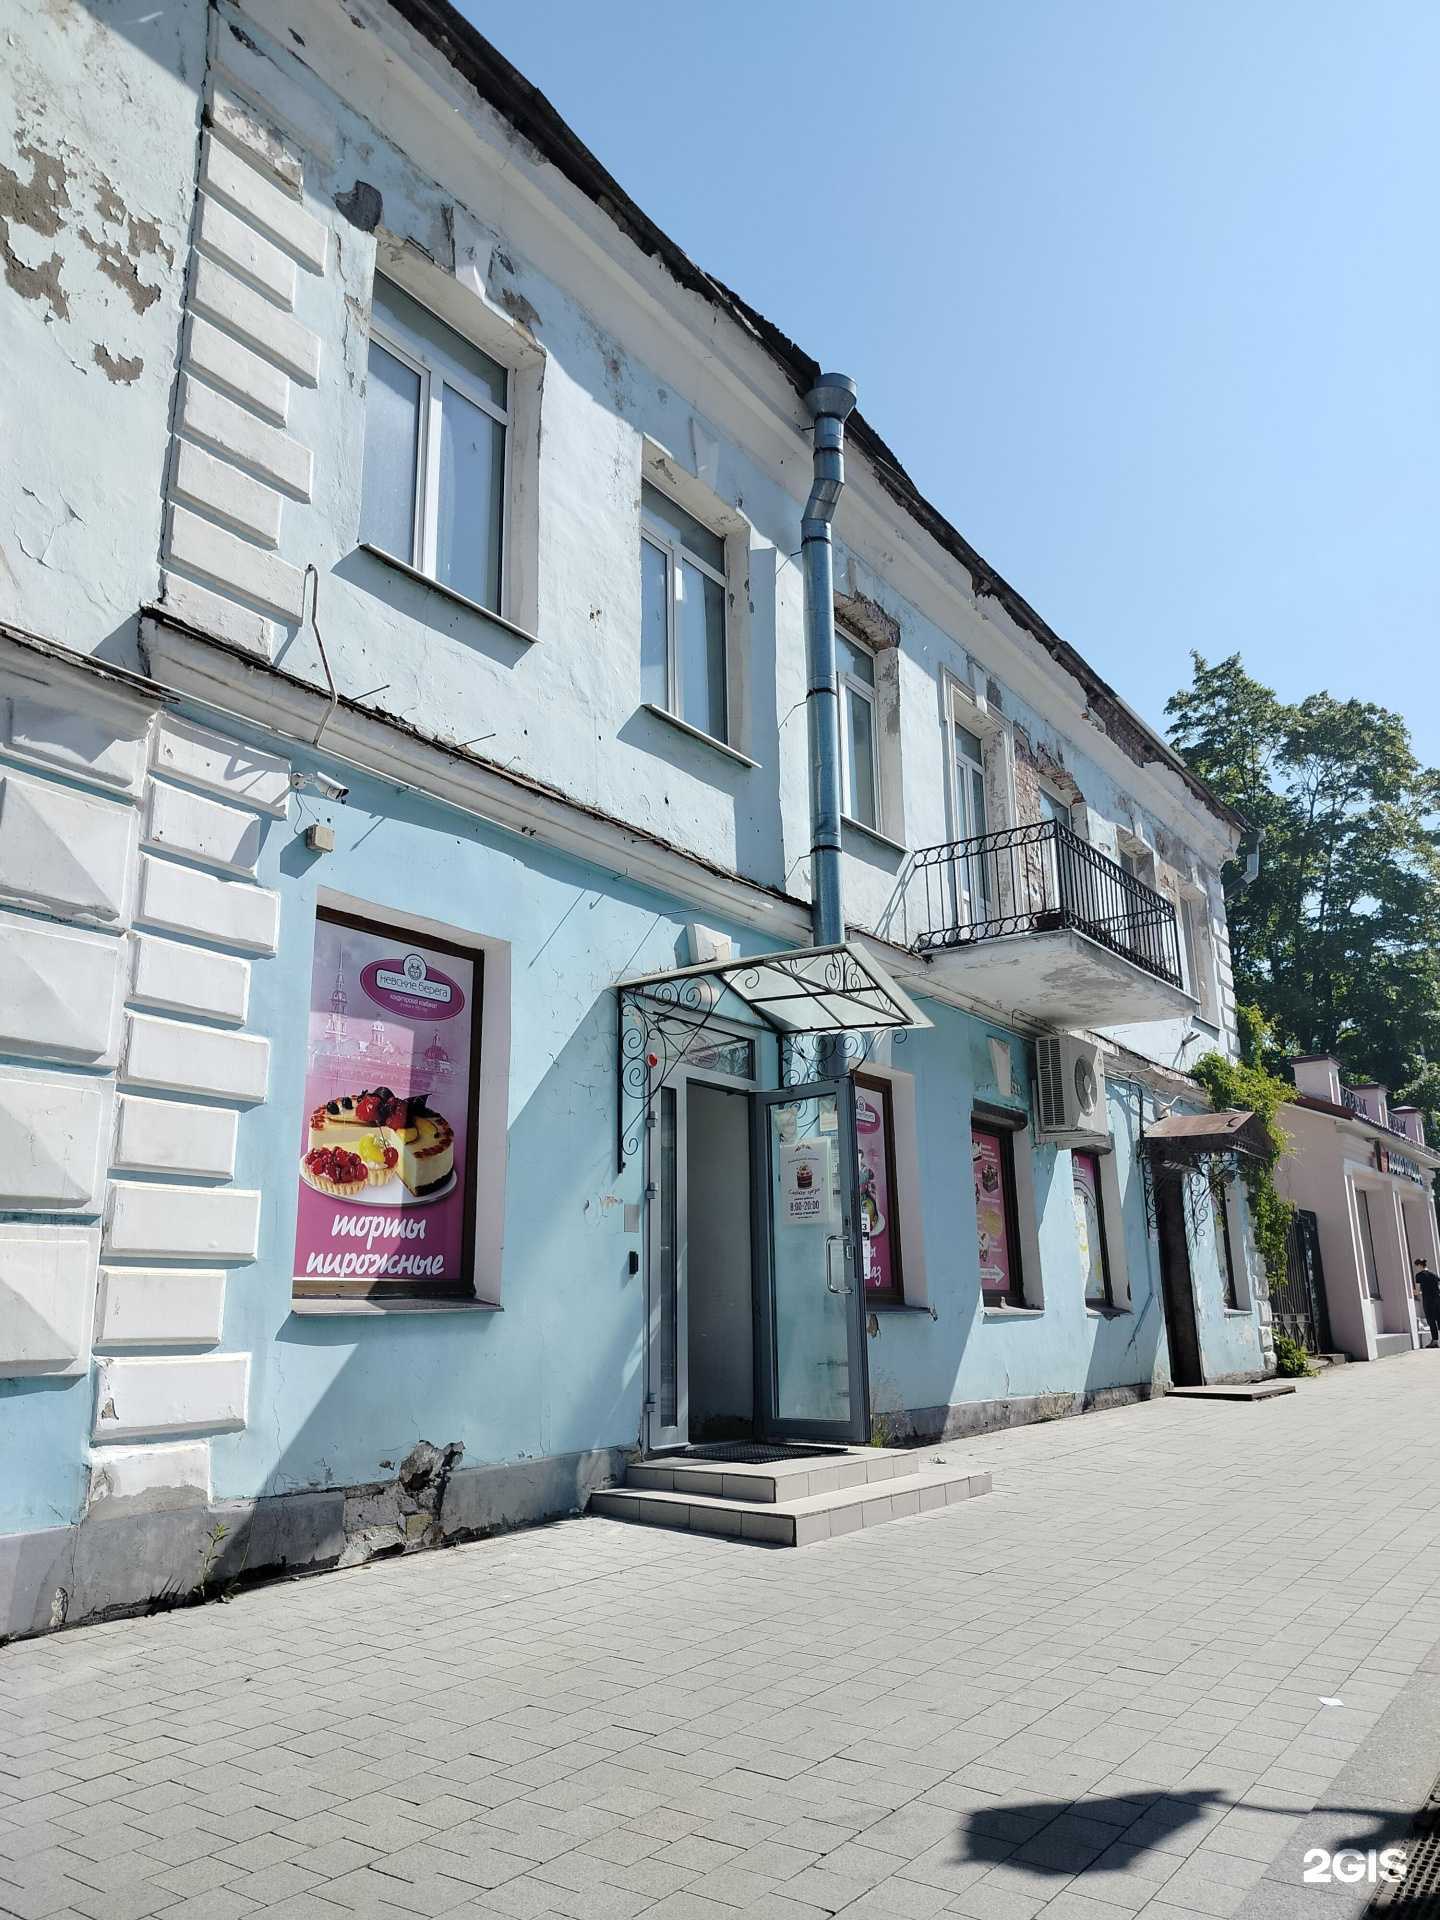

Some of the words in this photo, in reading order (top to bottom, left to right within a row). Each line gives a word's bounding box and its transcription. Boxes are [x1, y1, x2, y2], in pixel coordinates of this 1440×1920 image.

[418, 981, 448, 998] берега
[331, 1213, 427, 1250] торты
[306, 1252, 445, 1277] пирожные
